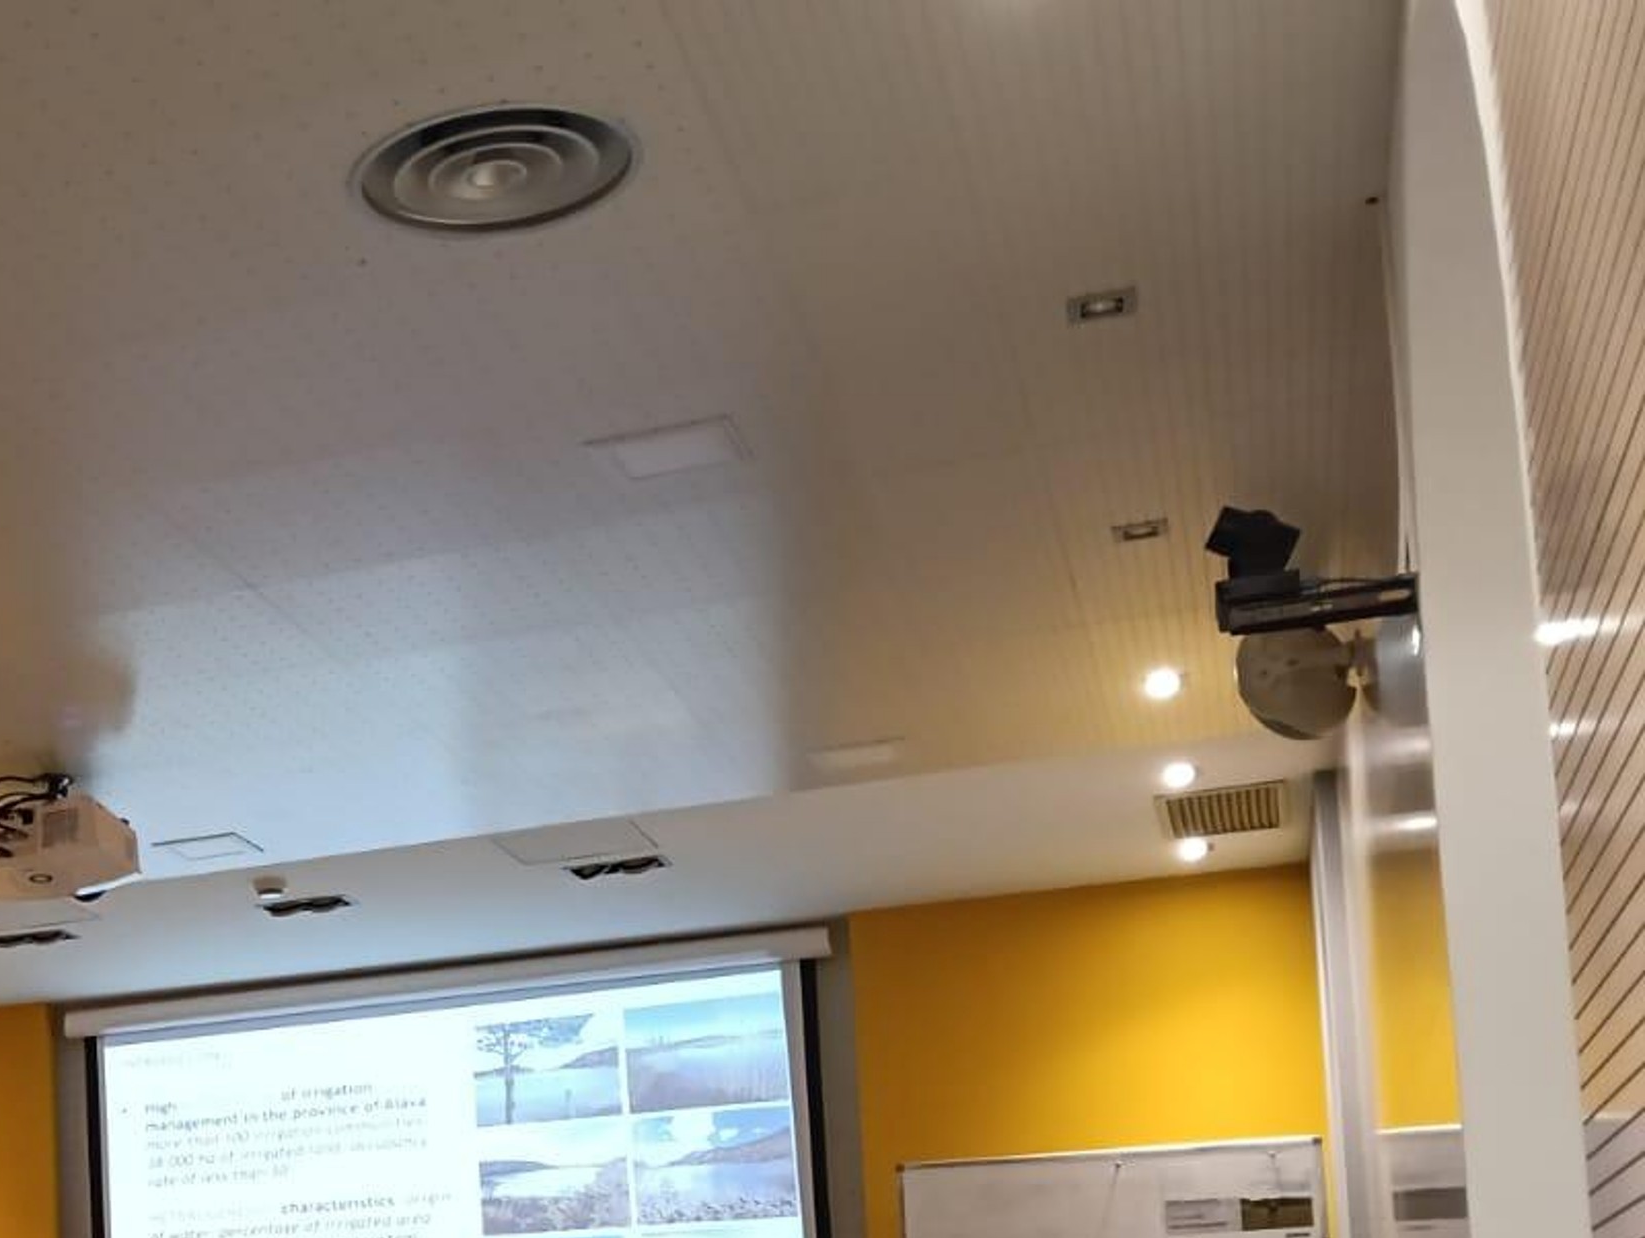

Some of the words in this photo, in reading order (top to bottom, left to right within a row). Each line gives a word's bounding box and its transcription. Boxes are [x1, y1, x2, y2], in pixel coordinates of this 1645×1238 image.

[302, 1083, 373, 1101] irrigation
[145, 1113, 238, 1133] management
[244, 1110, 258, 1123] in
[262, 1108, 287, 1122] the
[293, 1103, 359, 1121] province
[363, 1099, 380, 1113] of
[281, 1196, 395, 1215] characteristics
